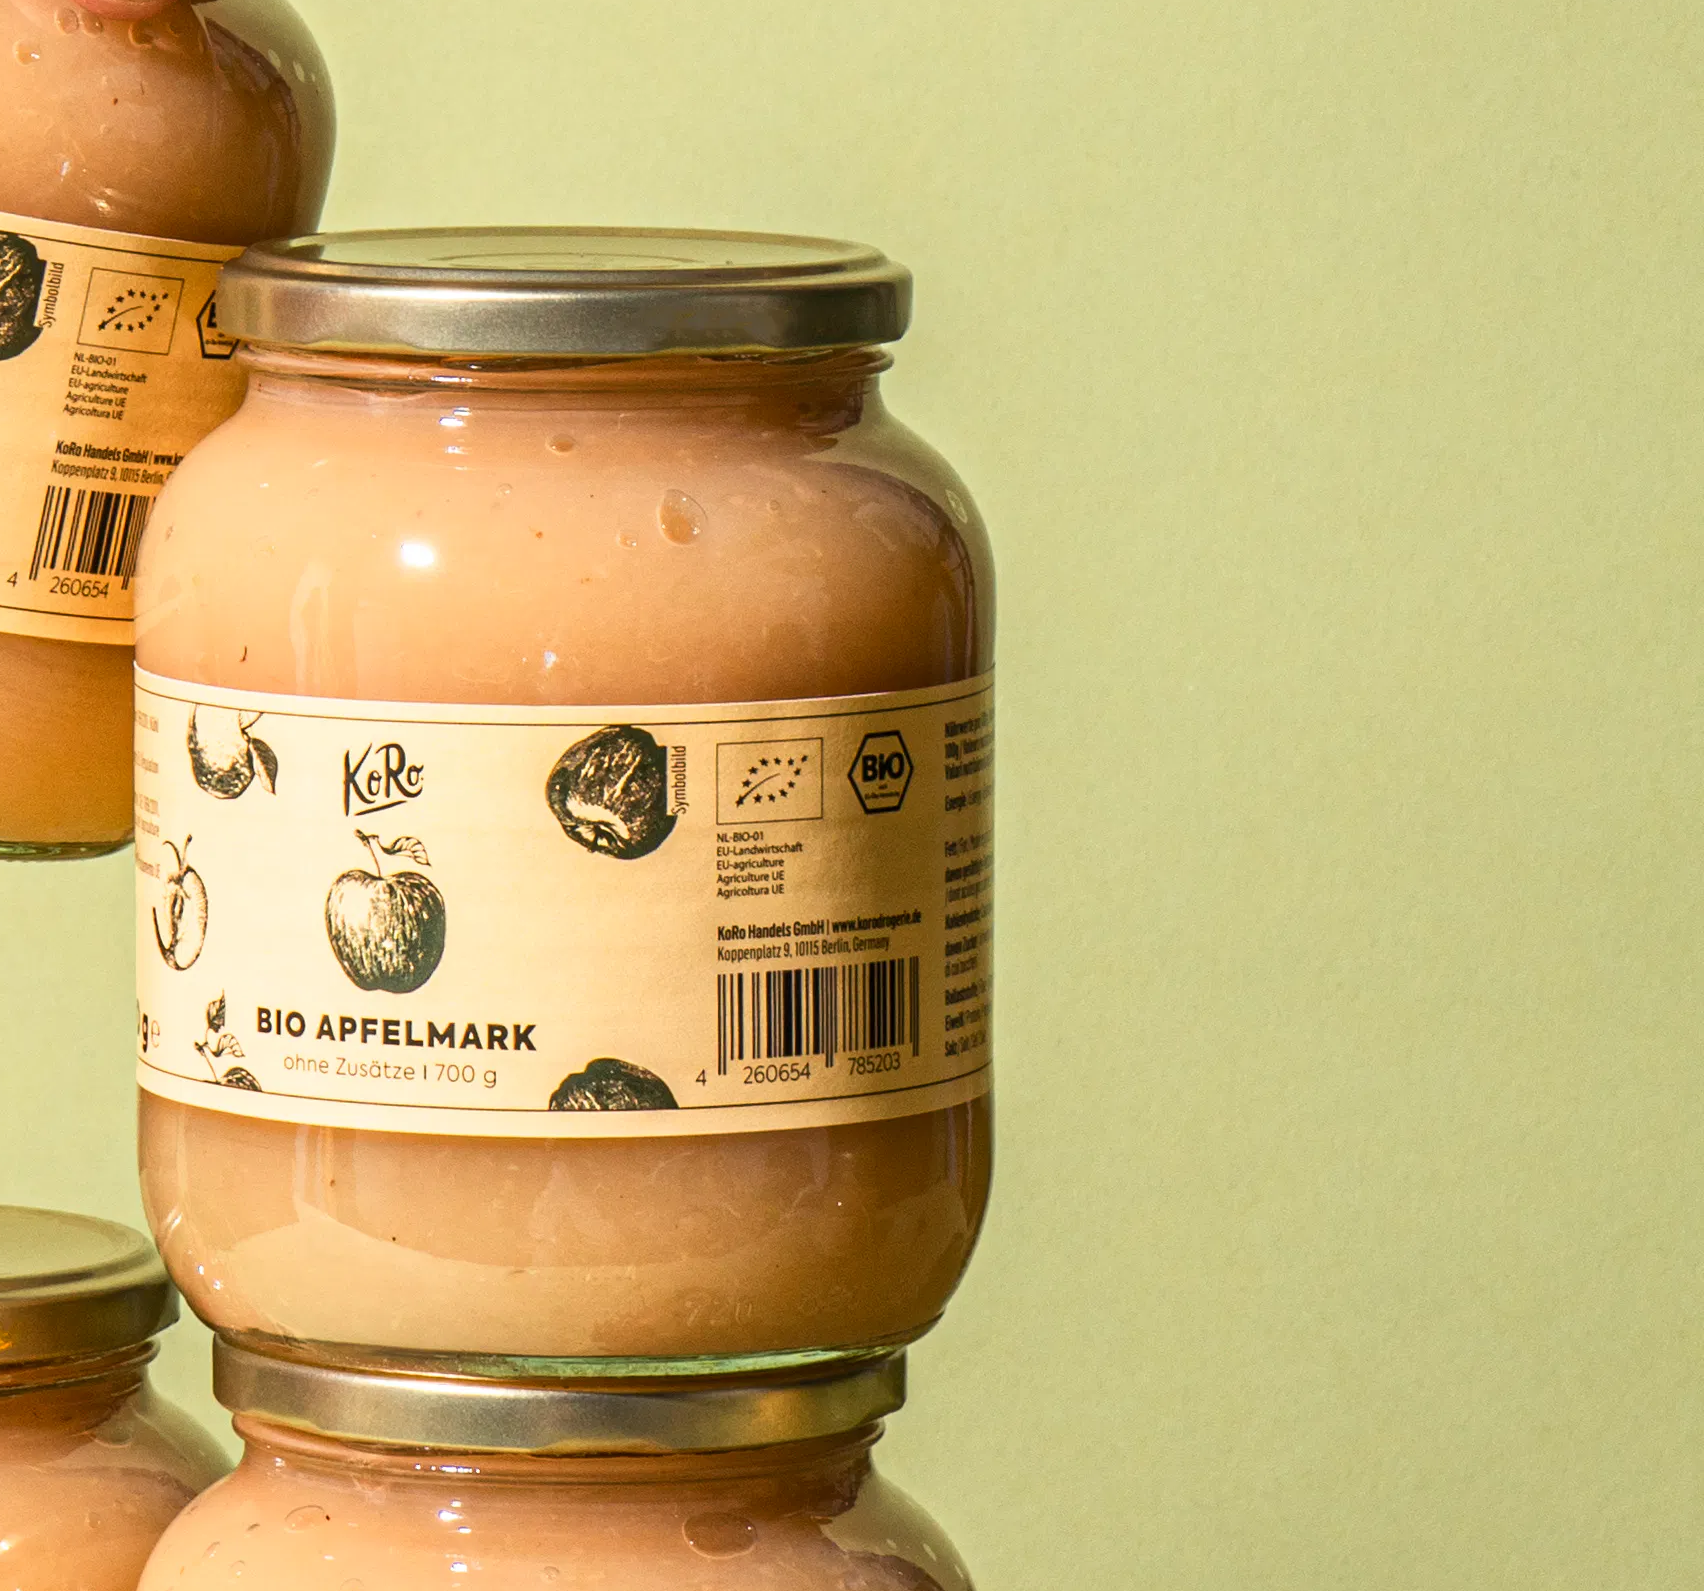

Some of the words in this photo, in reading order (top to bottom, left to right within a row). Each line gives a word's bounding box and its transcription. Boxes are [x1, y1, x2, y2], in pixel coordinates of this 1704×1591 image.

[38, 261, 64, 328] Symbolbild
[74, 352, 117, 367] NL-BIO-01
[71, 365, 148, 384] EU-Landwirtschaft
[68, 377, 129, 396] EU-agriculture
[65, 391, 113, 407] Agriculture
[115, 397, 127, 408] UE
[63, 404, 111, 420] Agricoltura
[112, 410, 124, 421] UE
[55, 440, 82, 456] KoRo
[83, 444, 121, 462] Handels
[122, 448, 149, 464] GmbH
[51, 459, 109, 480] Koppenplatz
[120, 467, 139, 483] 10115
[7, 571, 18, 587] 4
[49, 575, 110, 599] 260654
[344, 743, 424, 817] KoRo
[671, 745, 689, 815] Symbolbild
[716, 831, 764, 843] NL-BIO-01
[716, 842, 803, 856] EU-Landwirtschaft
[716, 858, 785, 872] EU-agriculture
[716, 872, 769, 886] Agriculture
[772, 871, 785, 881] UE
[716, 886, 770, 900] Agricoltura
[772, 884, 785, 895] UE
[717, 925, 746, 941] KoRo
[748, 923, 792, 939] Handels
[793, 920, 825, 936] GmbH
[717, 945, 782, 963] Koppenplatz
[783, 943, 793, 959] 9,
[795, 941, 819, 956] 10115
[821, 938, 851, 955] Berlin,
[853, 935, 890, 952] Germany
[256, 1007, 306, 1037] BIO
[316, 1014, 537, 1052] APFELMARK
[283, 1054, 329, 1074] ohne
[335, 1057, 416, 1081] Zusätze
[435, 1063, 475, 1084] 700
[483, 1068, 497, 1088] g
[695, 1069, 707, 1086] 4
[743, 1062, 811, 1085] 260654
[848, 1052, 901, 1075] 785203
